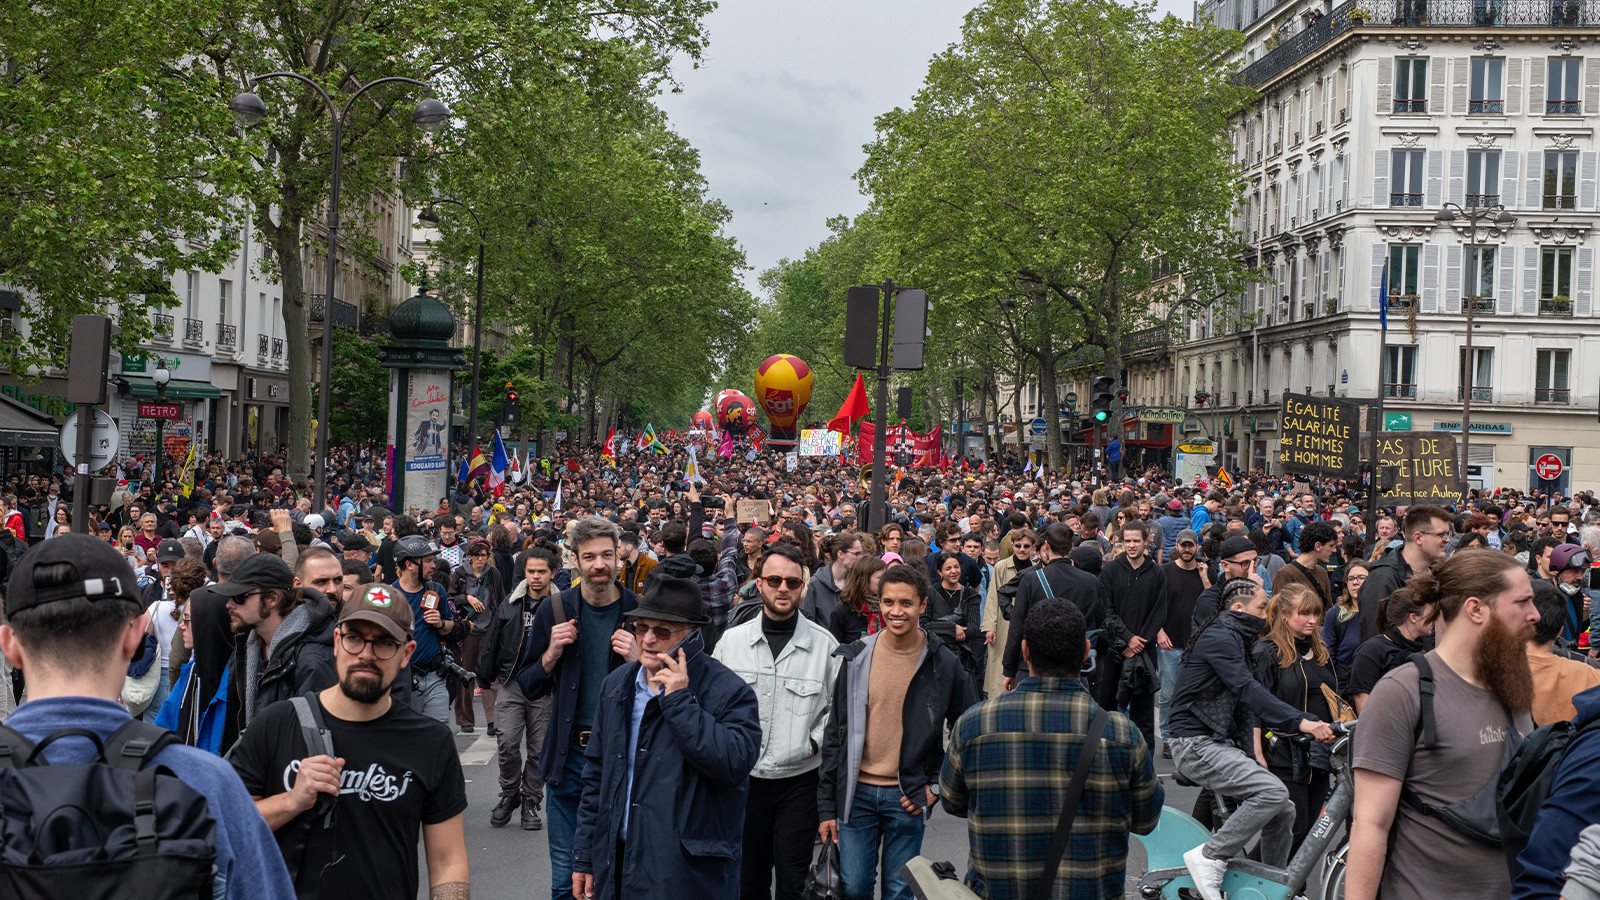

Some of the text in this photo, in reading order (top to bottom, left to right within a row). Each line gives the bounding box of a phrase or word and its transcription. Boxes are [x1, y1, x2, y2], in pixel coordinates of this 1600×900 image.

[142, 405, 177, 416] METRO
[765, 398, 793, 412] cgt
[800, 438, 837, 446] PALESTINE
[1280, 432, 1344, 453] des FEMMES
[1419, 438, 1440, 455] DE
[1280, 450, 1343, 469] et HOMMES
[1431, 484, 1462, 503] Aulnay
